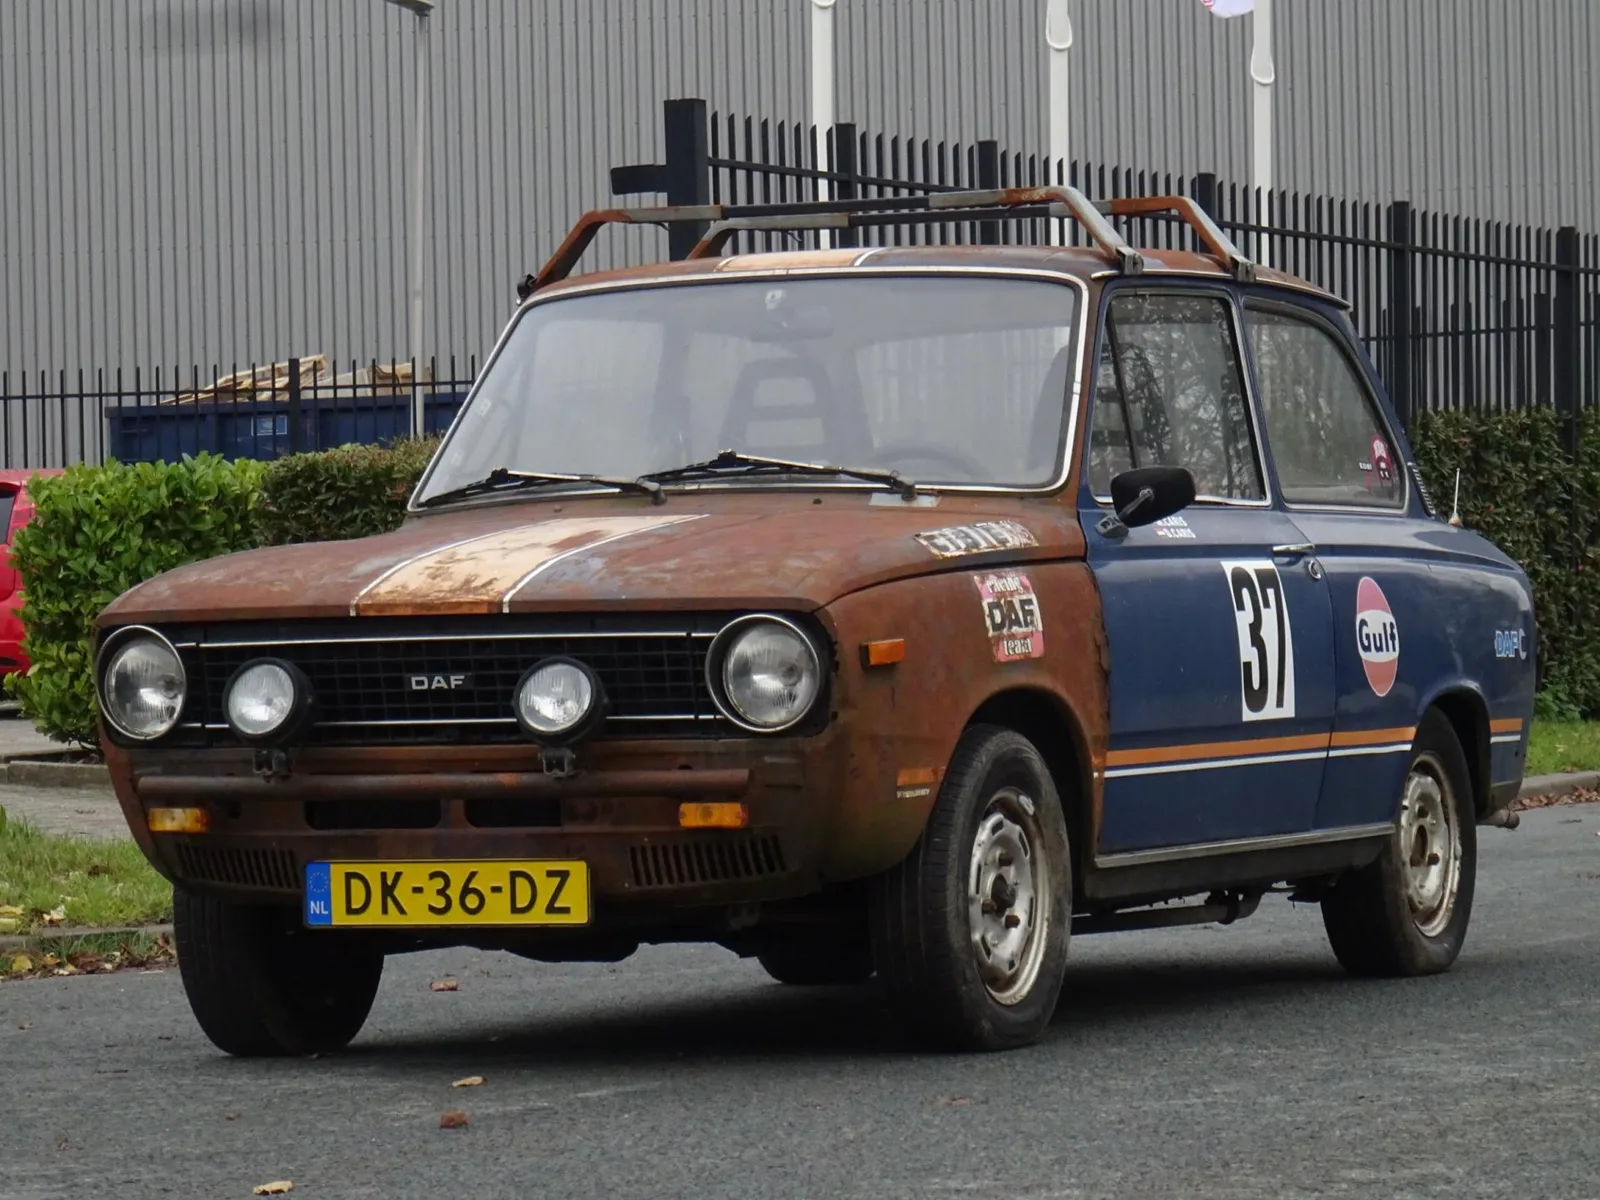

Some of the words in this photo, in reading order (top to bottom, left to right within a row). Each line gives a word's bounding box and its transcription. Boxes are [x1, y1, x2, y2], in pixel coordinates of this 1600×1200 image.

[986, 575, 1024, 594] racing
[987, 598, 1036, 632] DAF
[1231, 566, 1286, 713] 37
[1358, 618, 1397, 654] Gulf
[411, 675, 465, 690] DAF
[310, 901, 328, 914] NL
[344, 870, 571, 915] DK-36-DZ
